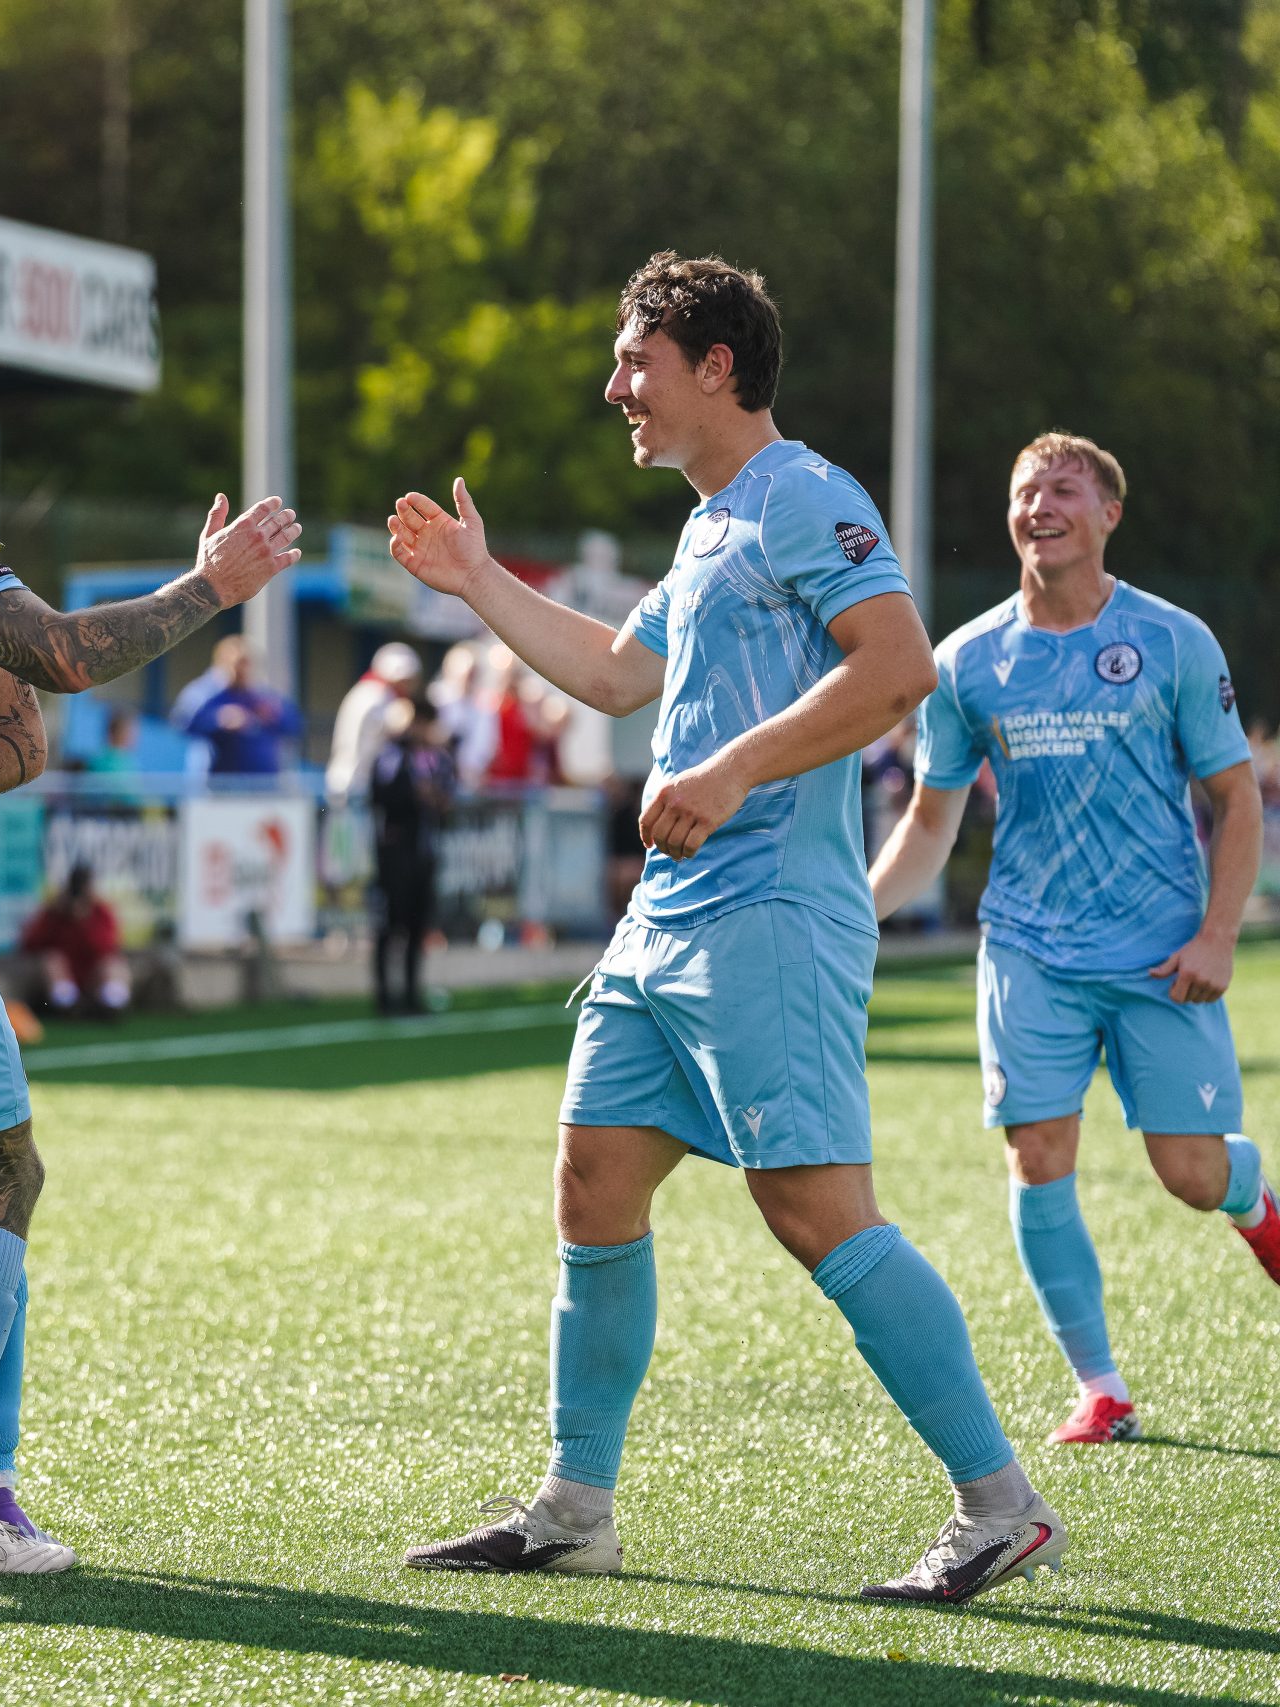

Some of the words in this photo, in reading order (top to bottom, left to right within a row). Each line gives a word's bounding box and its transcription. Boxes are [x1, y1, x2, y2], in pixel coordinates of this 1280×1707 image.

[835, 525, 863, 541] CYMRU
[840, 532, 878, 550] FOOTBALL
[845, 549, 857, 559] TV
[1004, 711, 1063, 730] SOUTH
[1066, 711, 1130, 727] WALES
[1006, 726, 1106, 744] INSURANCE
[1010, 741, 1087, 760] BROKERS
